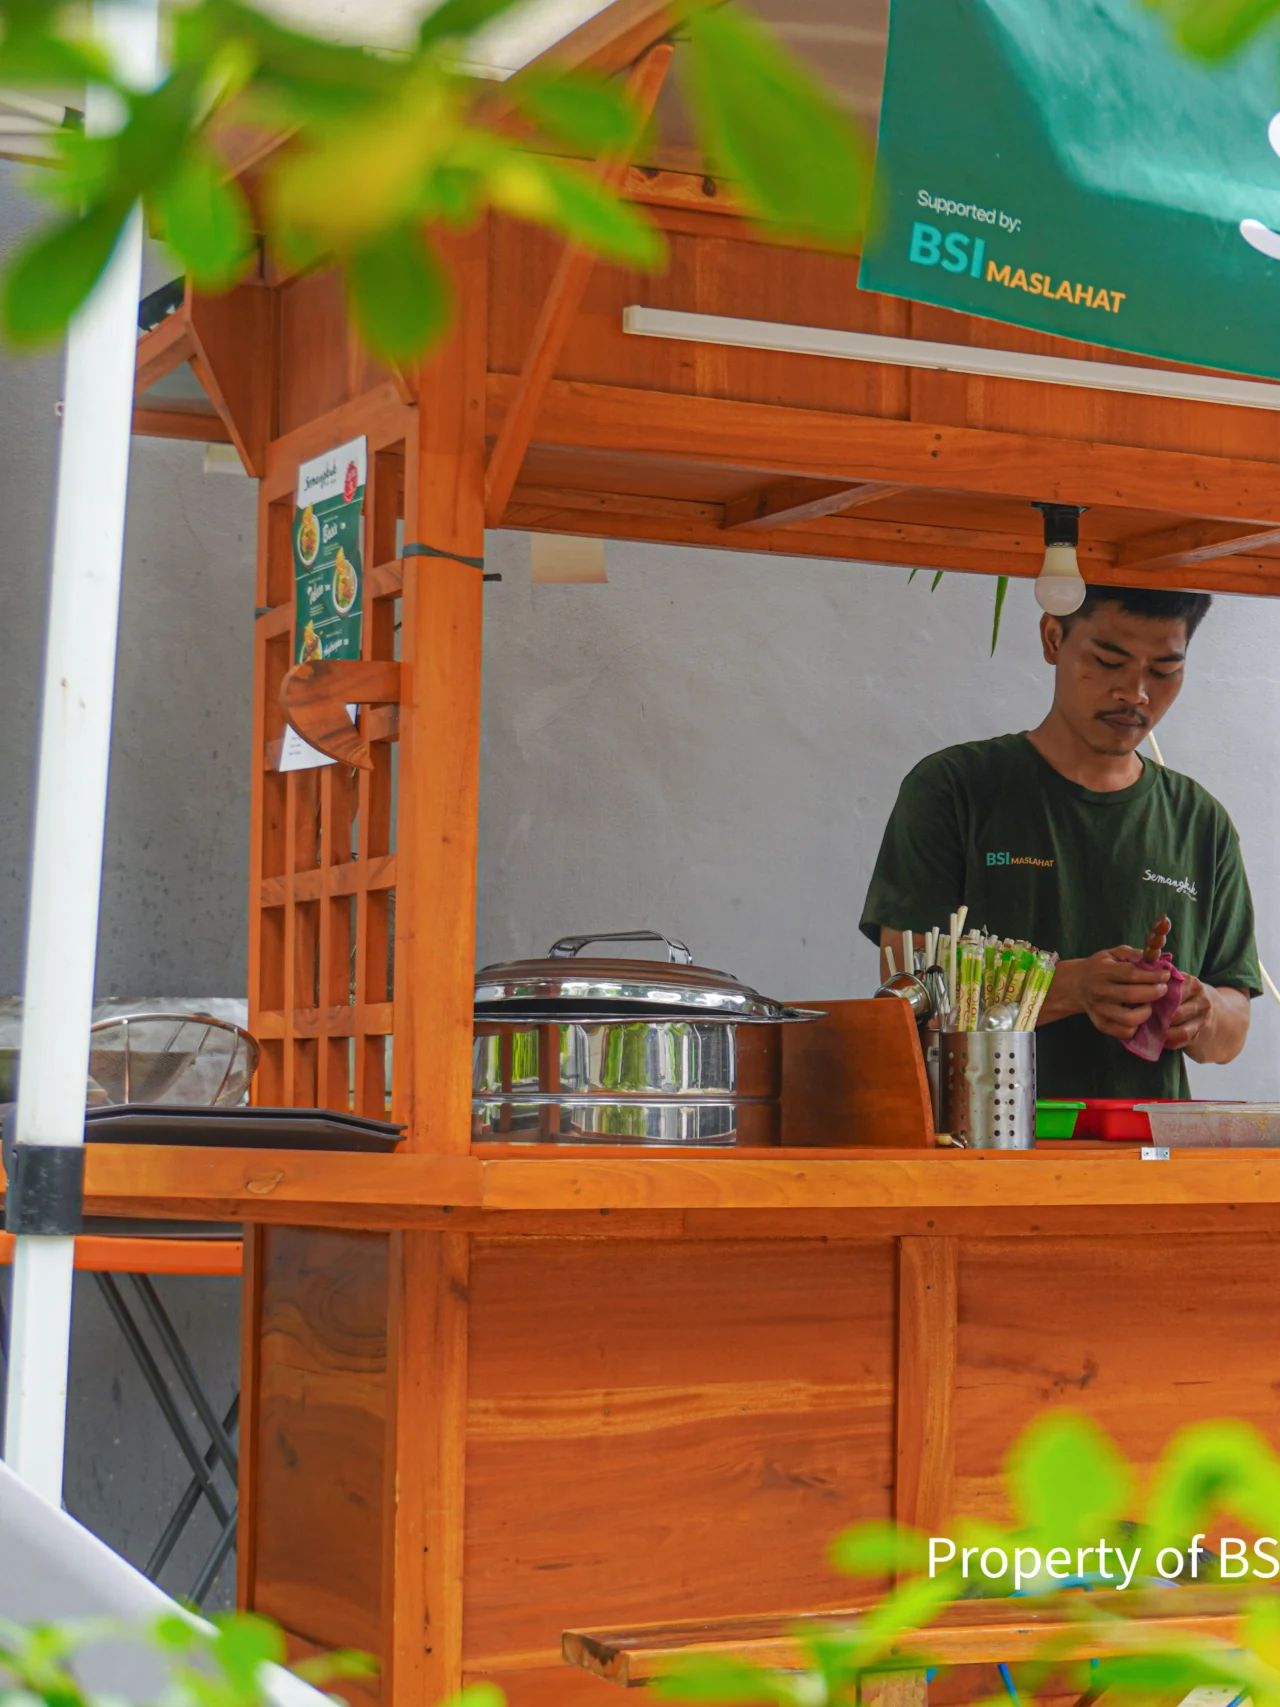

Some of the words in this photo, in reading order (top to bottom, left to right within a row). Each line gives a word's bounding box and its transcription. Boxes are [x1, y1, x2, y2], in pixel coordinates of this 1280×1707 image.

[916, 189, 997, 225] Supported
[999, 210, 1022, 234] by:
[908, 221, 986, 280] BSI
[985, 260, 1126, 314] MASLAHAT
[986, 852, 1010, 866] BSI
[1010, 856, 1055, 868] MASLAHAT
